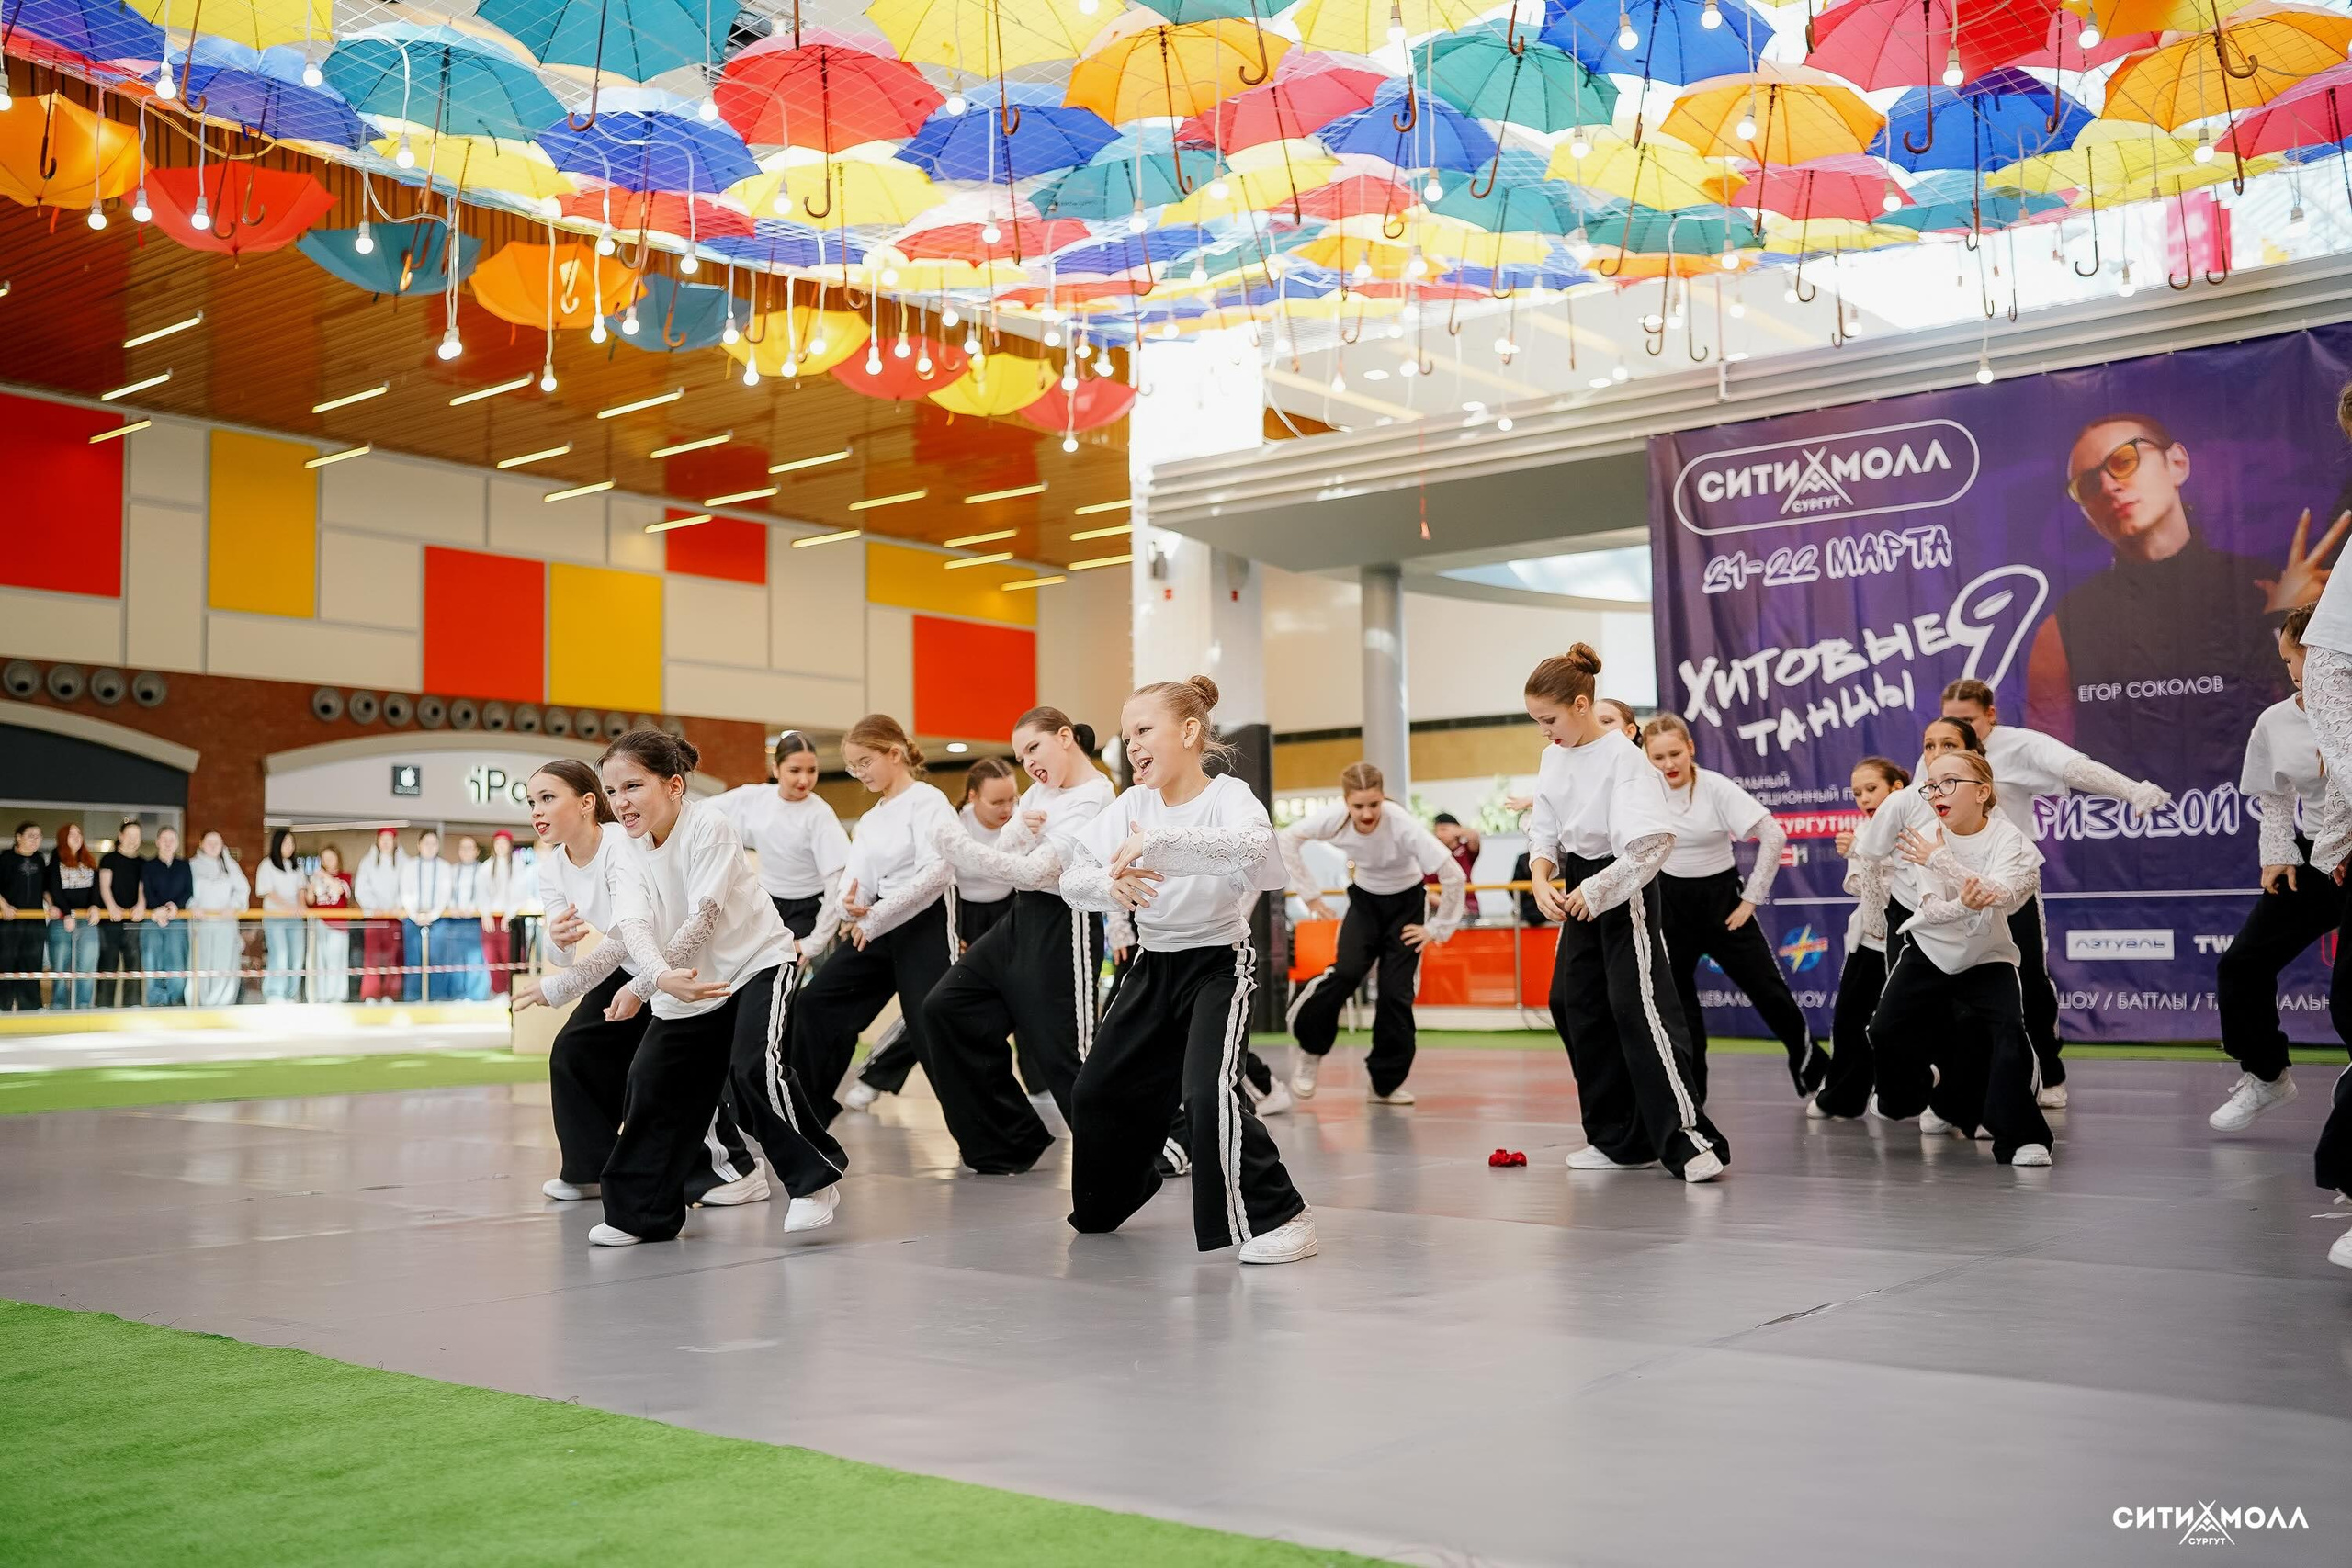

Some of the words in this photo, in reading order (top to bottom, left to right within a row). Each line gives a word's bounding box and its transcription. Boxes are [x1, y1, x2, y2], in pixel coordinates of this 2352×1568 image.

[1791, 495, 1841, 513] СУРГУТ
[1702, 544, 1820, 593] 21-22
[1826, 525, 1952, 580] МАРТА
[1678, 613, 1950, 728] ХИТОВЫЕ
[2078, 682, 2122, 702] ЕГОР
[2126, 675, 2224, 699] СОКОЛОВ
[1738, 669, 1916, 757] ТАНЦЫ
[469, 765, 528, 803] iPo
[2032, 782, 2240, 841] РИЗОВОЙ
[2193, 935, 2234, 954] TW
[2117, 991, 2188, 1010] БАТТЛЫ
